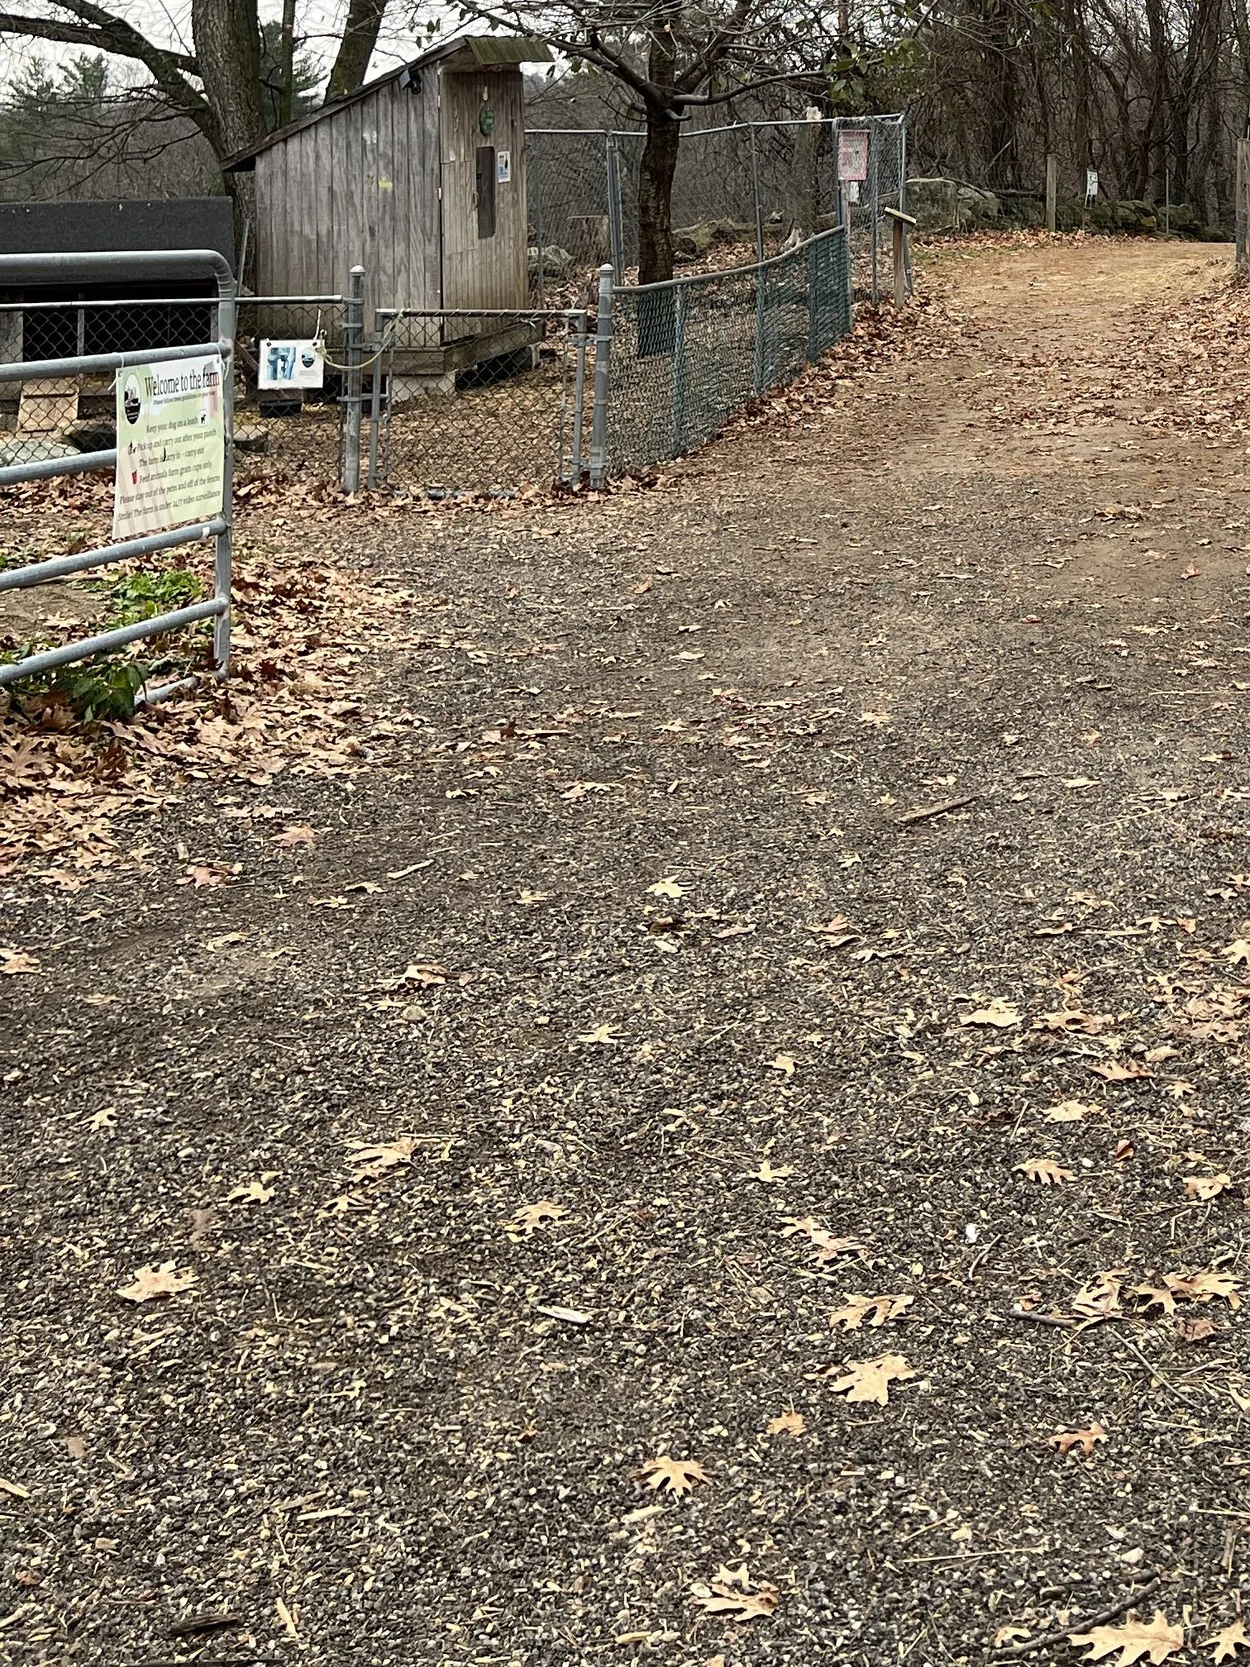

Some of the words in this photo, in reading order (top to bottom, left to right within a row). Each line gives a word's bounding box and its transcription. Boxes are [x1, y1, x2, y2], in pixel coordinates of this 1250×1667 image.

[144, 374, 179, 397] Welcome
[181, 375, 188, 392] to
[190, 369, 201, 390] the
[202, 368, 220, 388] farm
[168, 420, 177, 430] dog
